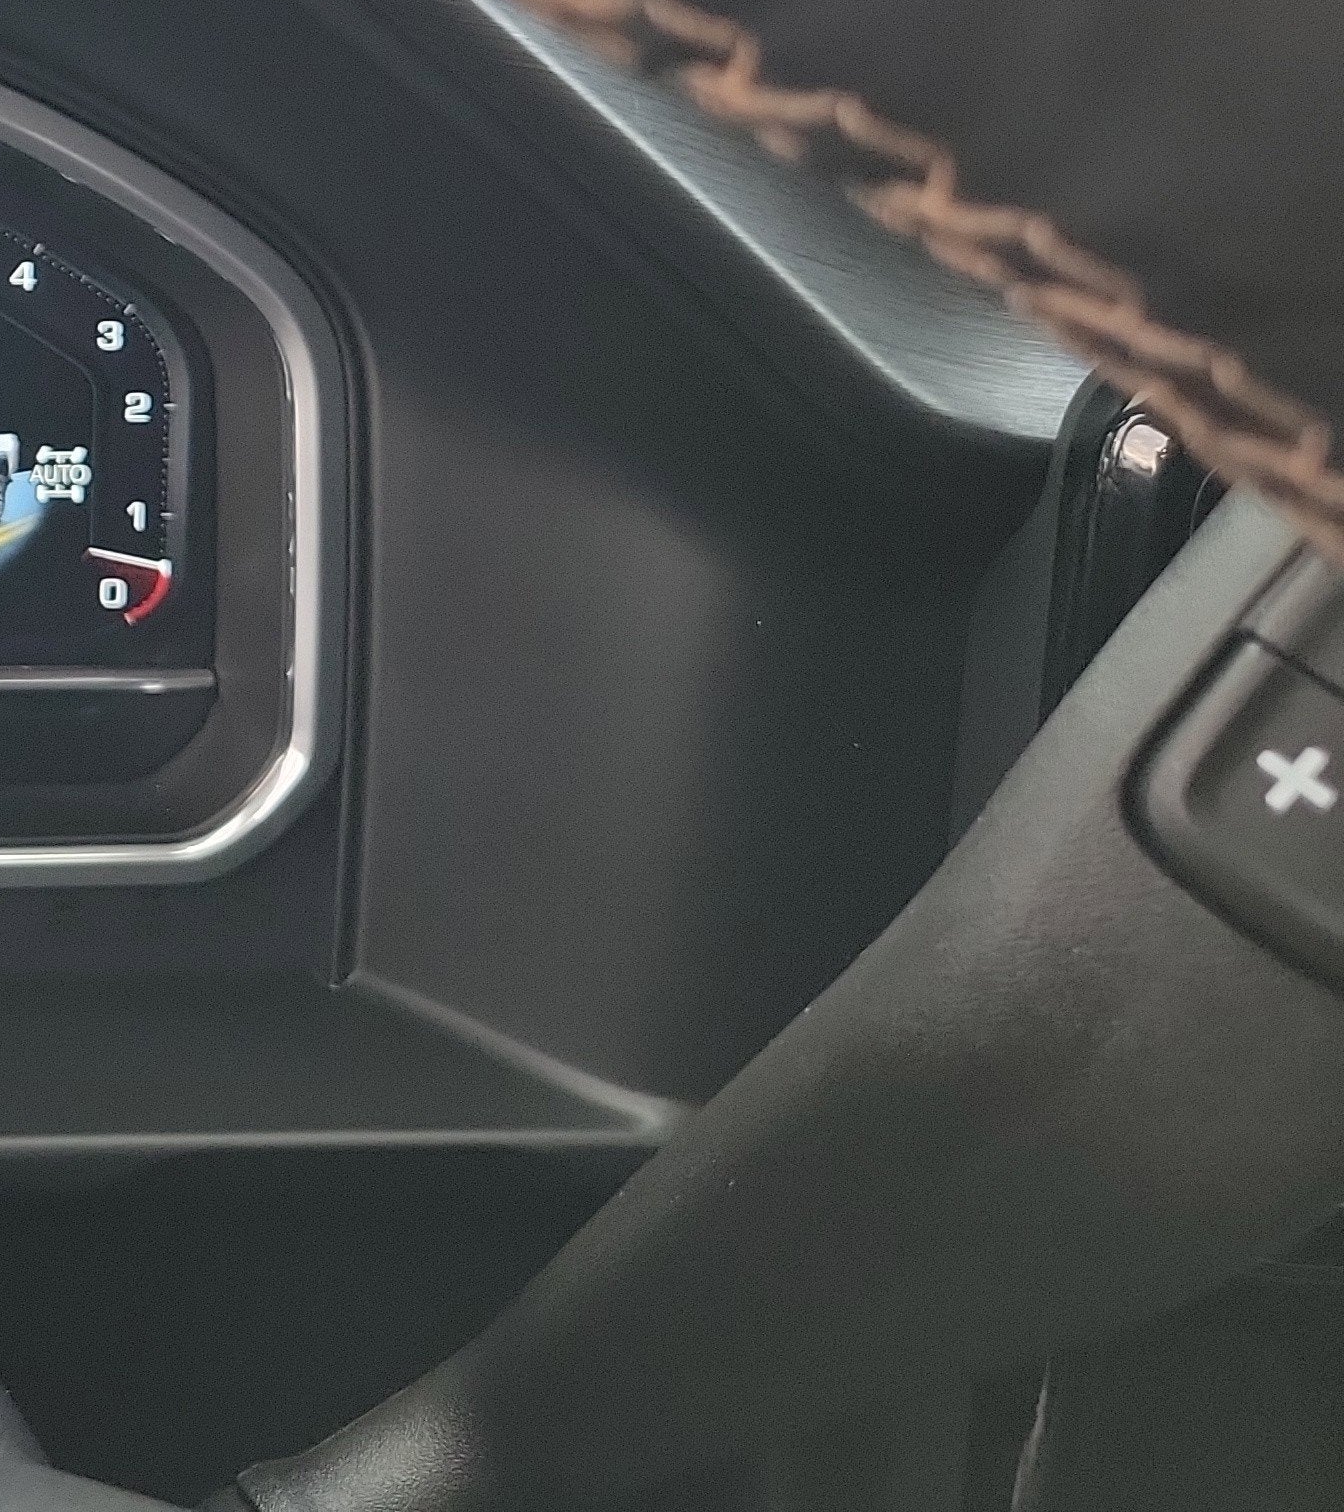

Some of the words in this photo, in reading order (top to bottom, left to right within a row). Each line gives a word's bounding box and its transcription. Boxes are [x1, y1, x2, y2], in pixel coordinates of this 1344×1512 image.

[9, 261, 38, 292] 4
[96, 320, 125, 351] 3
[124, 392, 153, 424] 2
[29, 463, 93, 486] AUTO
[126, 501, 147, 532] 1
[99, 577, 128, 610] 0
